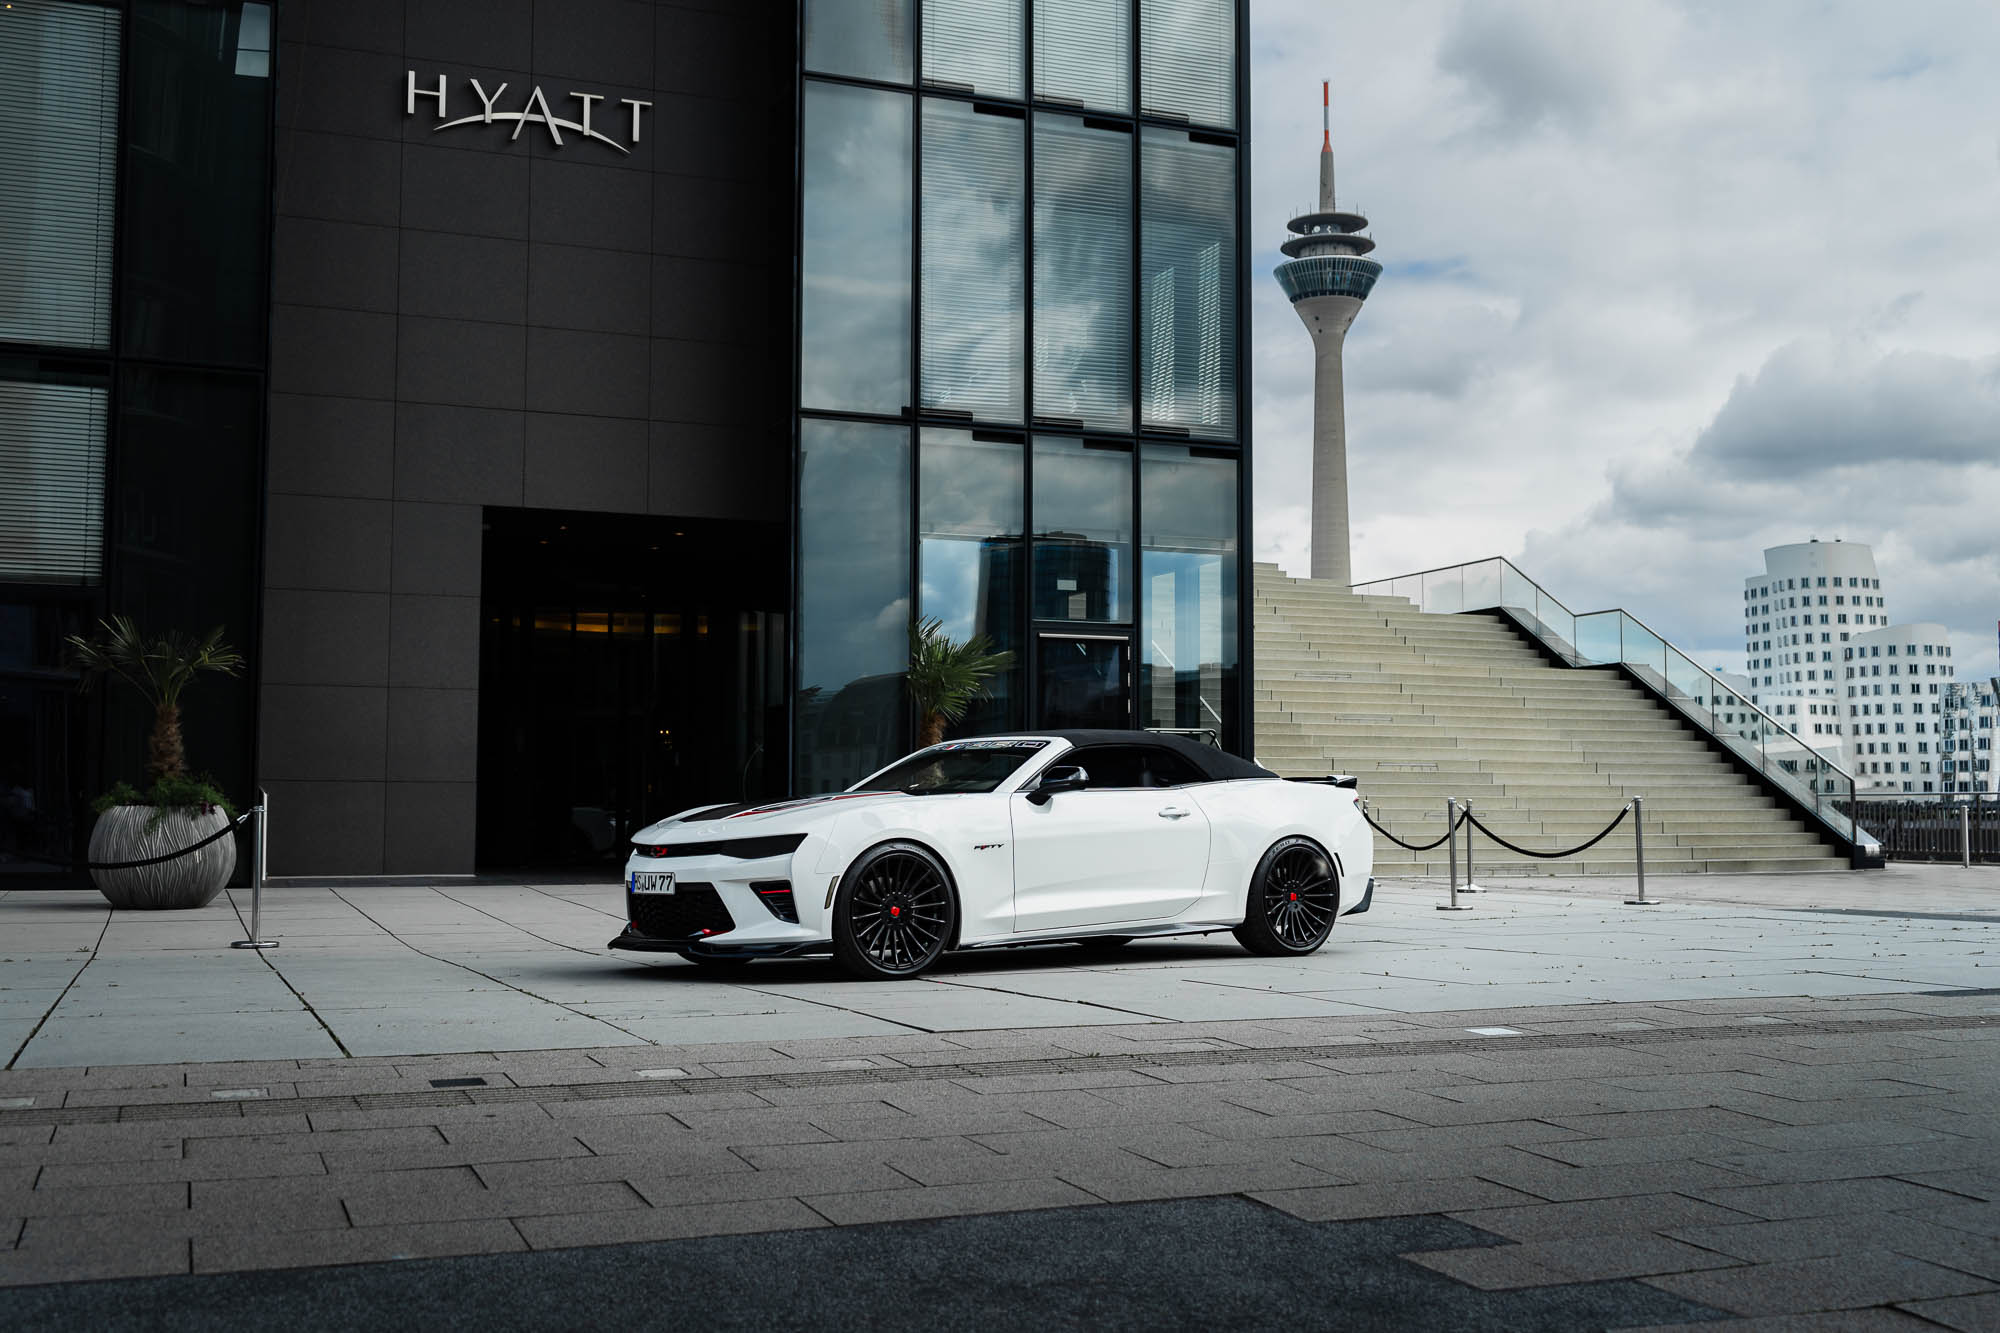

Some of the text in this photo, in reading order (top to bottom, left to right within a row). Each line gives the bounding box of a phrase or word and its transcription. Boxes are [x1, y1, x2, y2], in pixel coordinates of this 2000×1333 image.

[407, 70, 653, 147] HYATT
[644, 874, 657, 891] UW
[659, 875, 673, 892] 77
